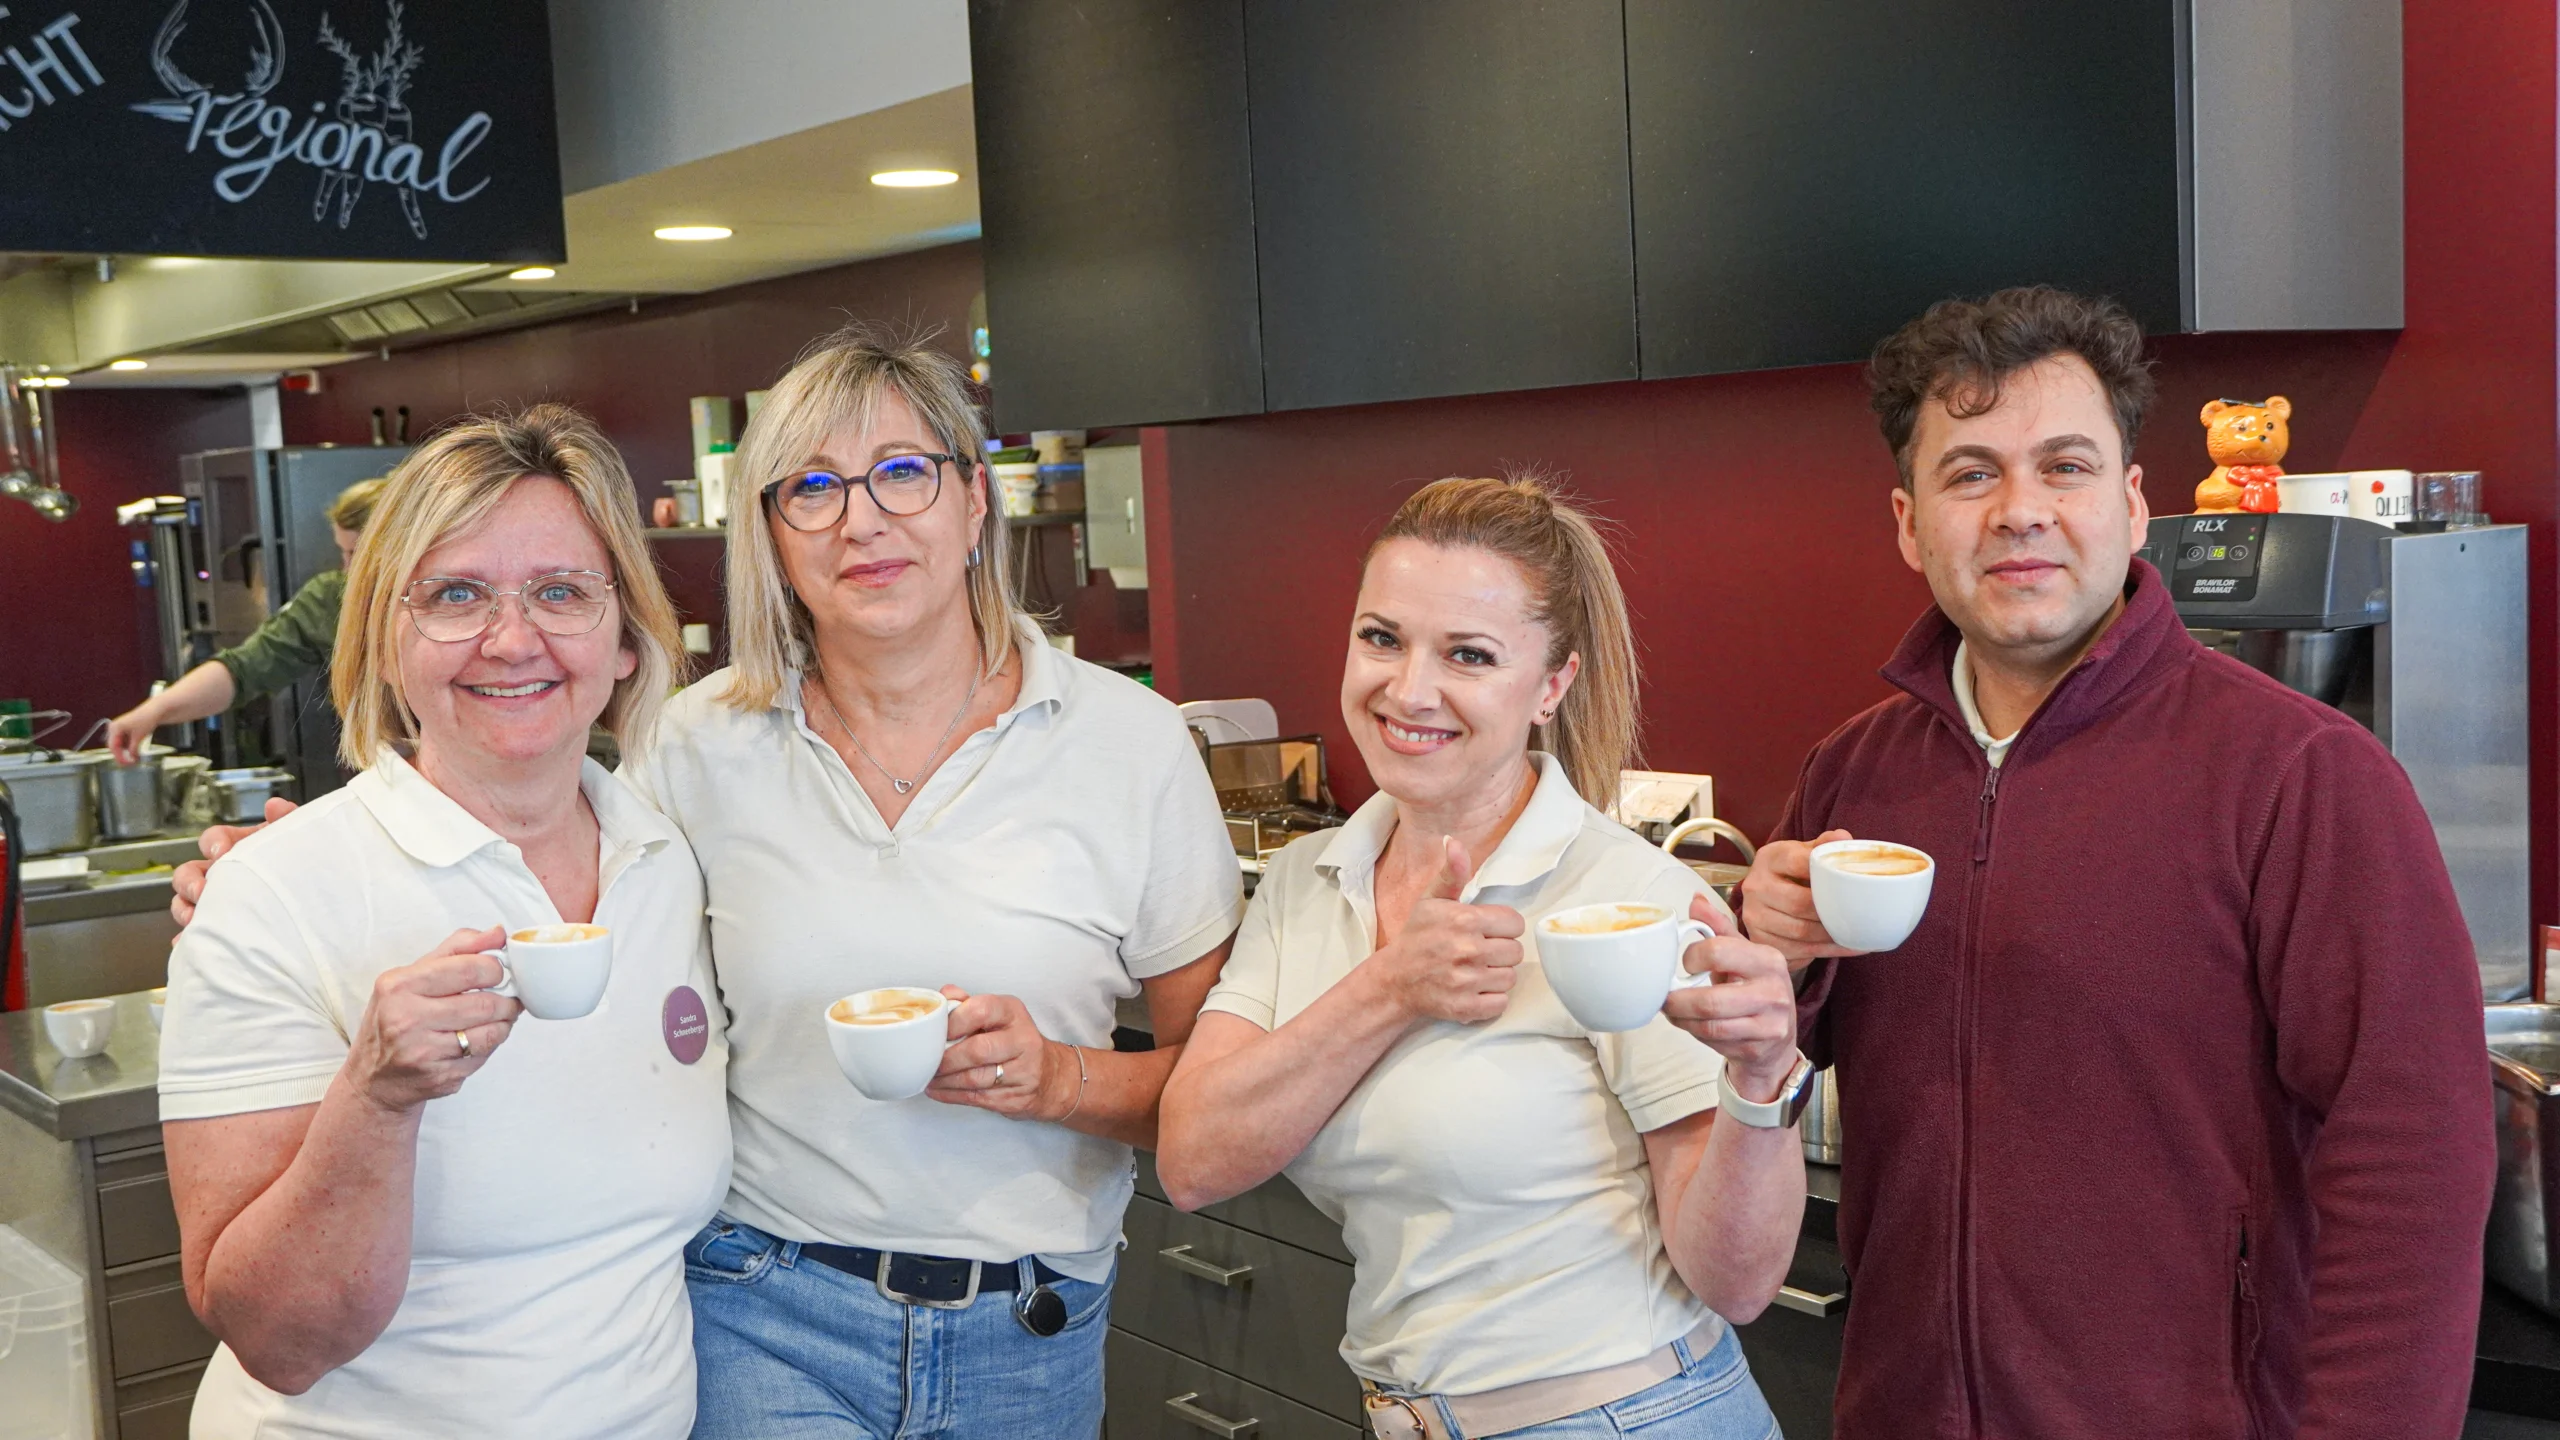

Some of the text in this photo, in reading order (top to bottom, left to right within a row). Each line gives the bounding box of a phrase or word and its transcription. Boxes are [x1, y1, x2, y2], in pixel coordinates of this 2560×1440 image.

[186, 91, 492, 202] regional
[2193, 519, 2229, 532] RLX
[679, 1014, 697, 1024] Sandra
